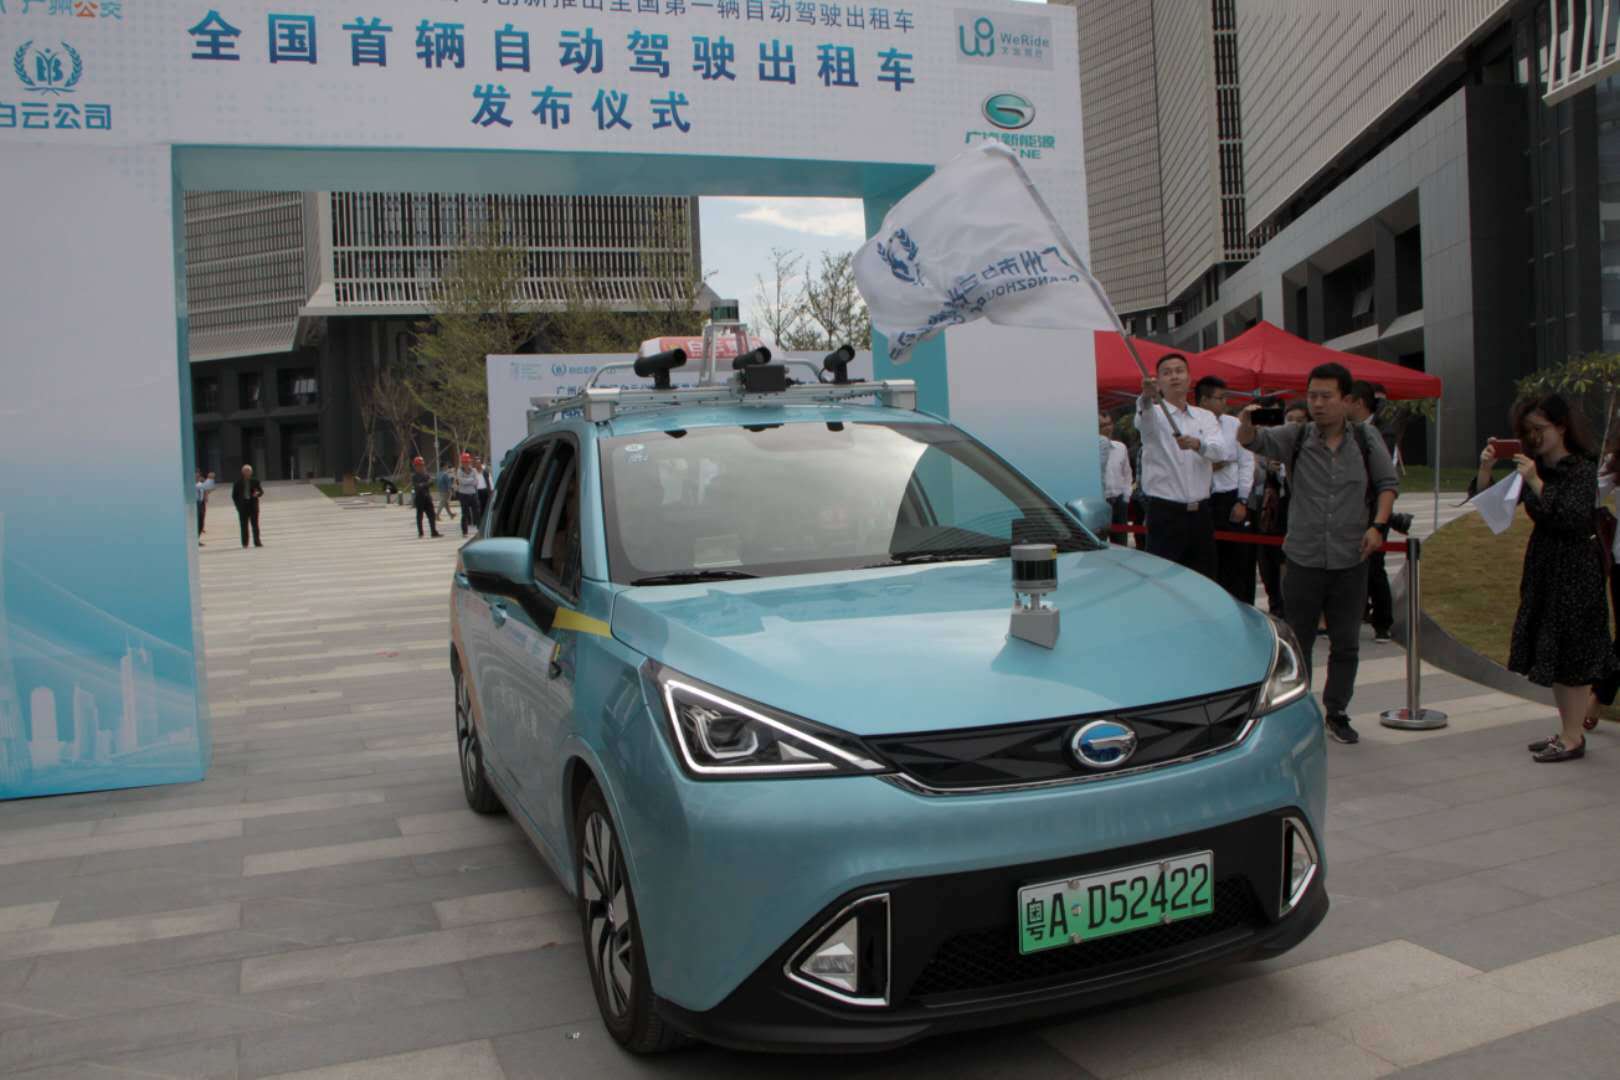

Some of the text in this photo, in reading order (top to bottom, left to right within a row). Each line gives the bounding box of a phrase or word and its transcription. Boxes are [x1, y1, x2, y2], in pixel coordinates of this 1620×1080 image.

[188, 10, 915, 91] 全国首辆自动驾驶出租车
[1000, 32, 1050, 48] WeRide
[471, 84, 691, 132] 发布仪式
